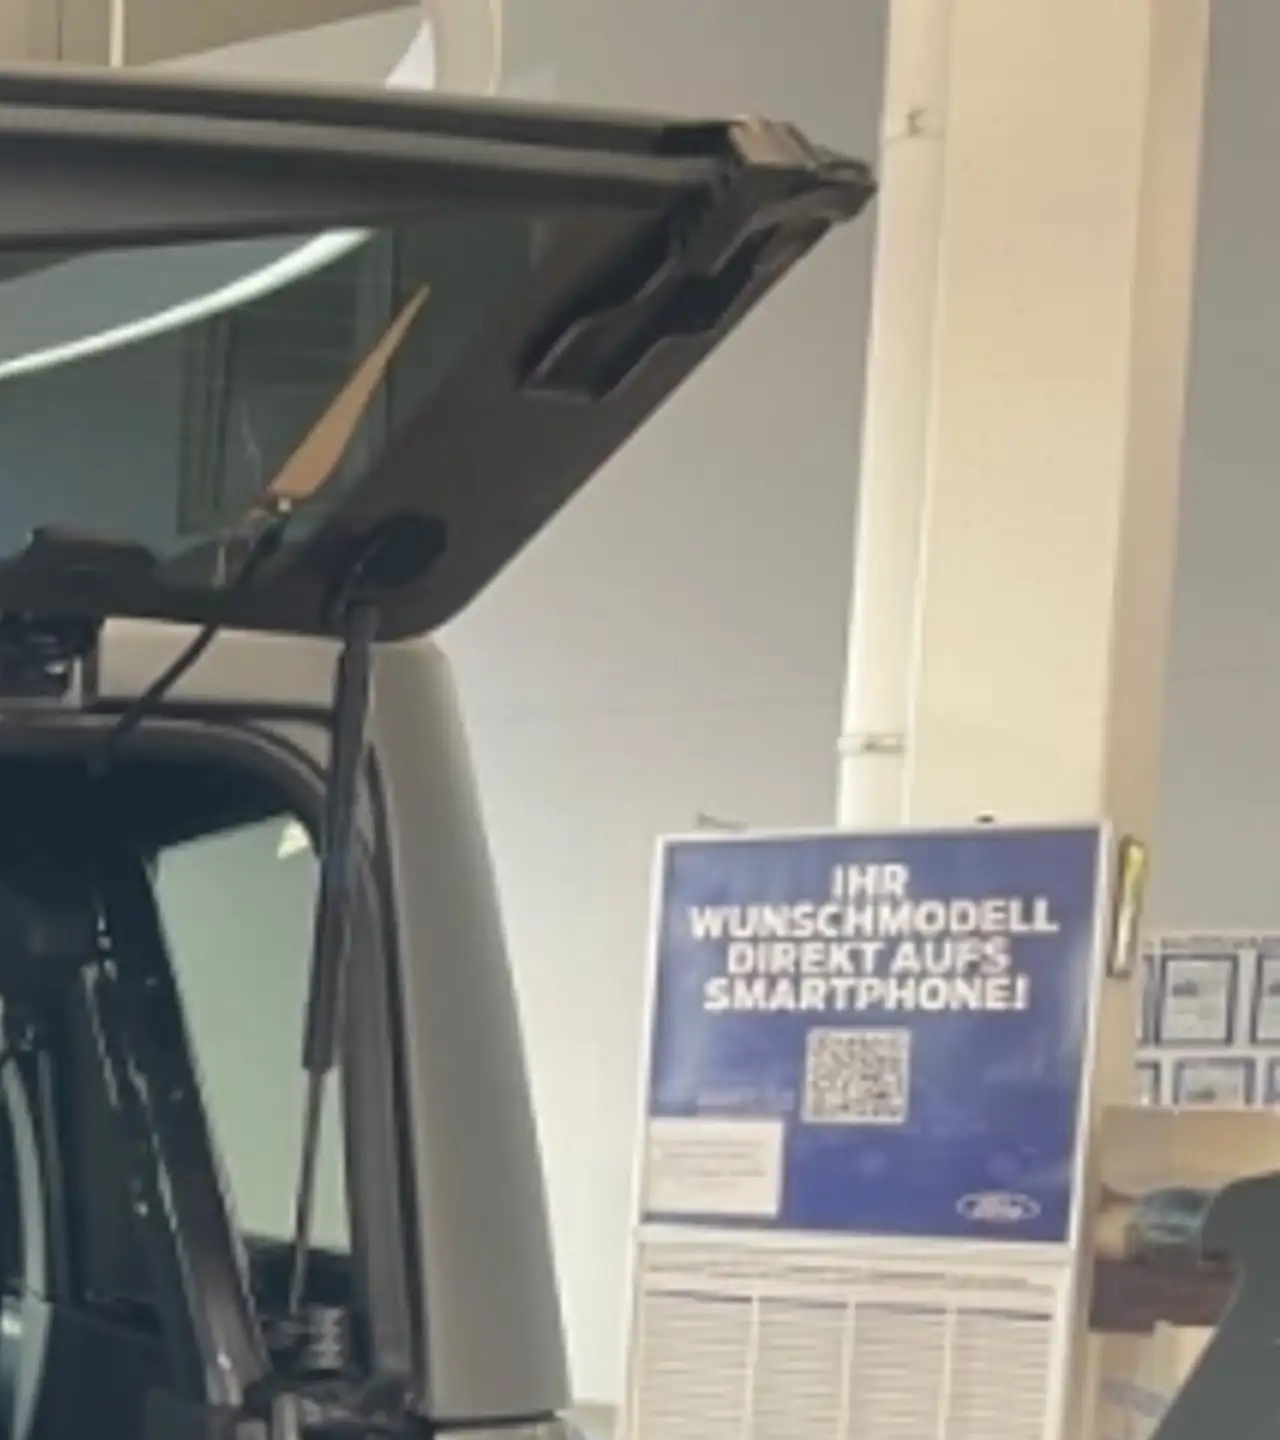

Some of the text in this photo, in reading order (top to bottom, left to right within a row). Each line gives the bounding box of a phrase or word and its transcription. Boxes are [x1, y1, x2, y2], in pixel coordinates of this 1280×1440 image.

[831, 863, 909, 899] IHR
[688, 898, 1059, 938] WUNSCHMODELL
[727, 936, 1011, 974] DIREKT AUFS
[703, 974, 1029, 1012] SMARTPHONE!
